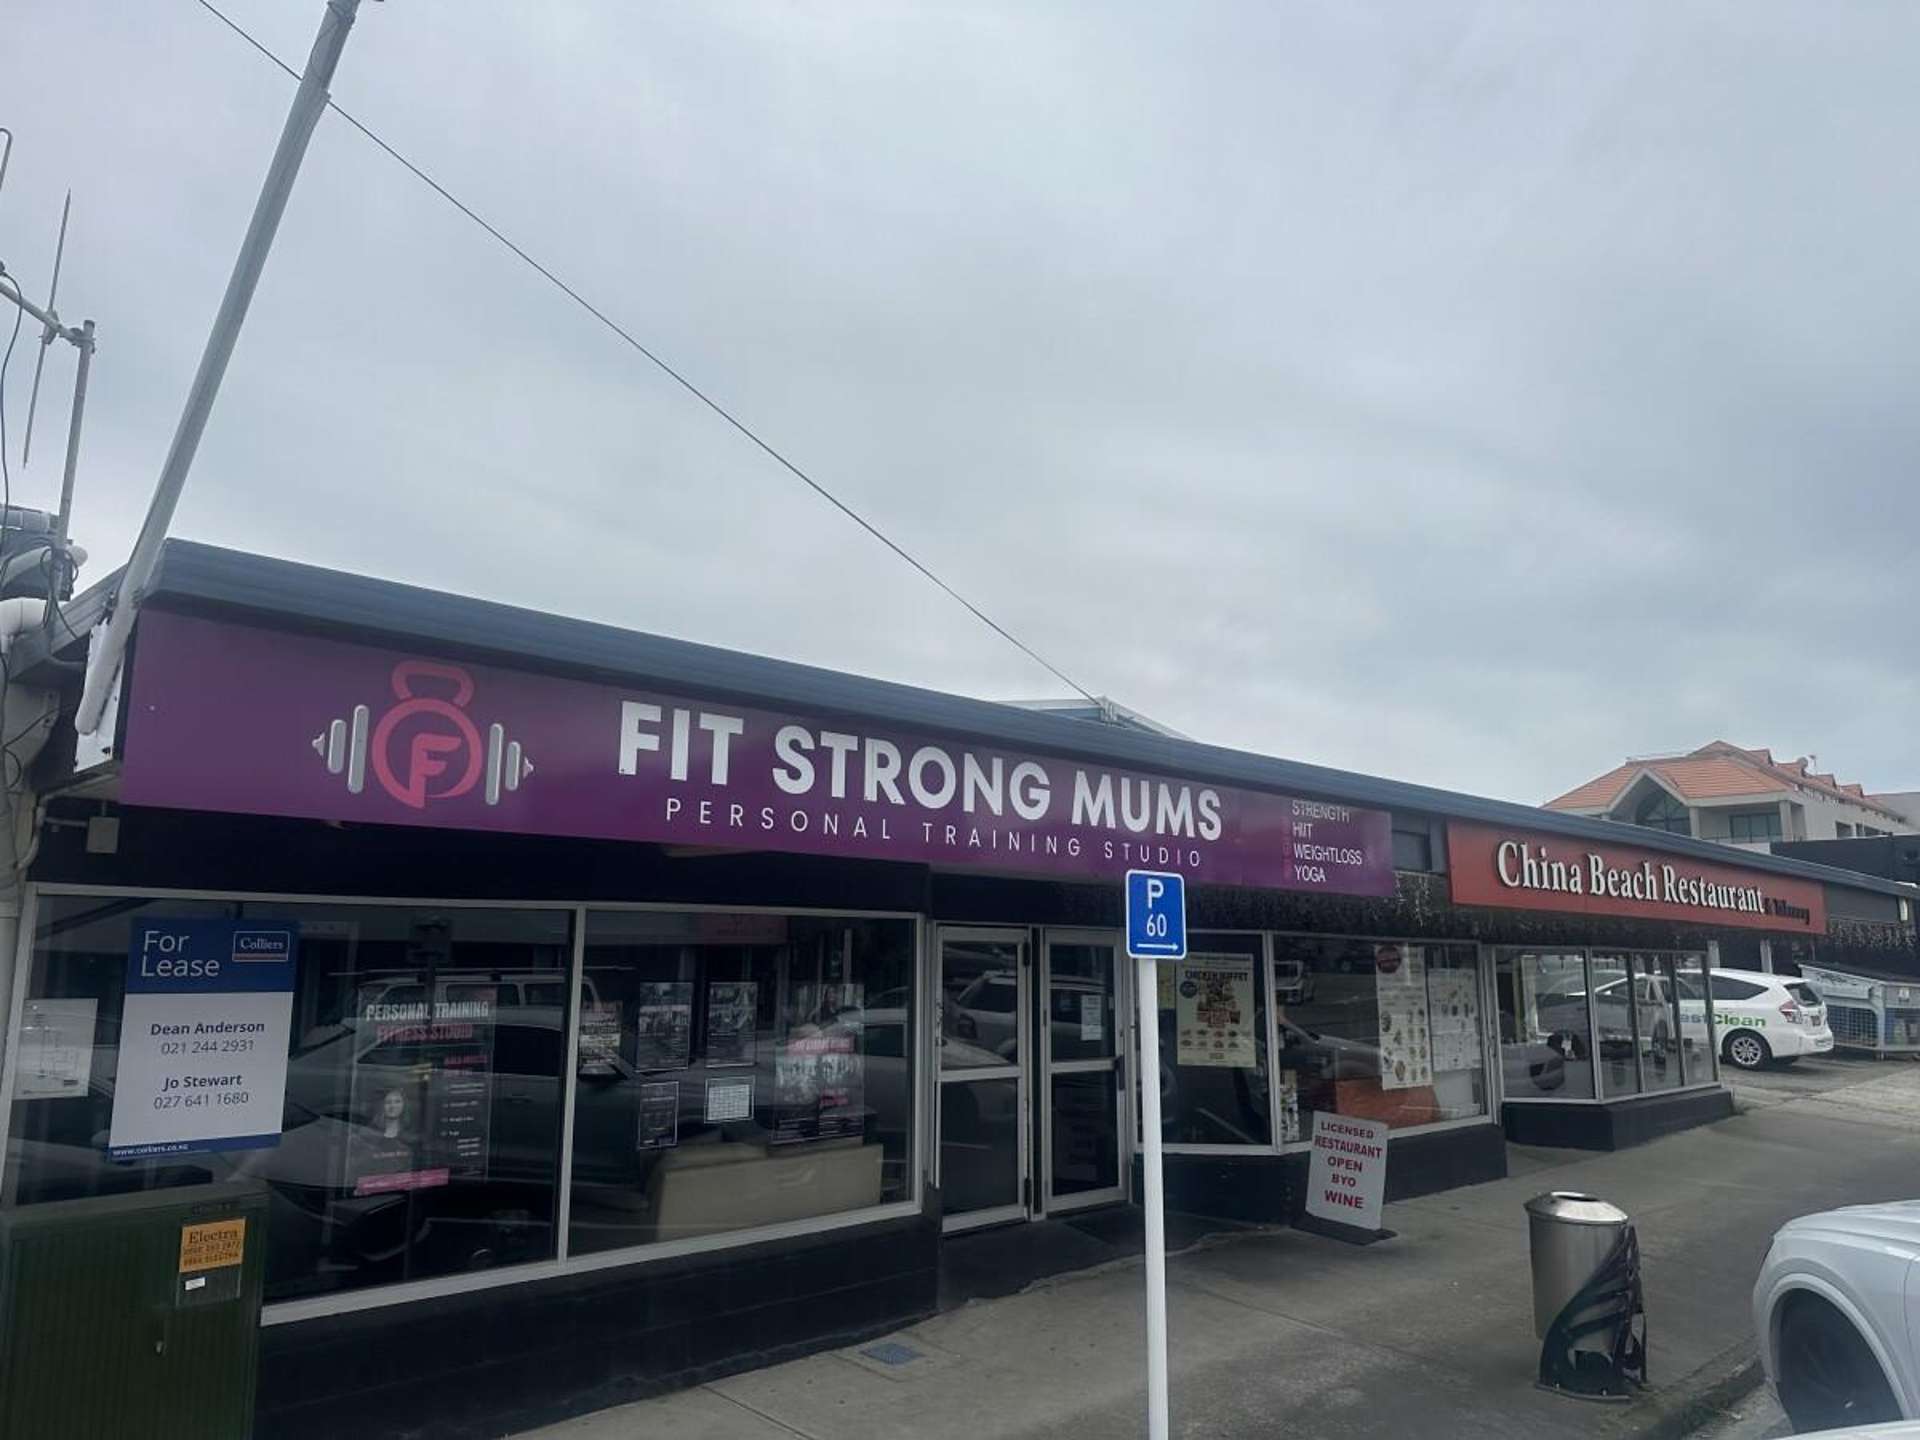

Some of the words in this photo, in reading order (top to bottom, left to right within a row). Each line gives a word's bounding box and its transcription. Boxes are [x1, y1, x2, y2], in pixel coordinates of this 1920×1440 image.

[619, 701, 744, 785] FIT
[772, 725, 1050, 820] STRONG
[1071, 770, 1222, 841] MUMS
[1292, 800, 1350, 823] STRENGTH
[666, 798, 891, 840] PERSONAL
[922, 822, 1081, 856] TRAINING
[1104, 841, 1200, 867] STUDIO
[1293, 843, 1363, 865] WEIGHTLOSS
[1294, 864, 1327, 882] YOGA
[1497, 840, 1583, 894] China
[1587, 853, 1658, 900] Beach
[1661, 864, 1765, 914] Restaurant
[1147, 879, 1164, 909] P
[1146, 914, 1167, 937] 60
[144, 930, 190, 952] For
[240, 937, 283, 950] Colliers
[141, 955, 220, 977] Lease
[366, 1002, 431, 1021] PERSONAL
[434, 1001, 489, 1018] TRAINING
[151, 1023, 190, 1035] Dean
[194, 1021, 265, 1034] Anderson
[161, 1042, 186, 1054] 021
[192, 1041, 218, 1053] 244
[222, 1040, 254, 1052] 2931
[162, 1078, 179, 1092] Jo
[183, 1074, 242, 1088] Stewart
[153, 1096, 181, 1110] 027
[185, 1094, 209, 1107] 641
[216, 1091, 249, 1105] 1680
[1321, 1121, 1374, 1139] LICENSED
[1314, 1135, 1382, 1158] RESTAURANT
[1327, 1156, 1362, 1172] OPEN
[1331, 1173, 1356, 1187] BYO
[1324, 1190, 1363, 1209] WINE
[189, 1229, 239, 1243] Electra
